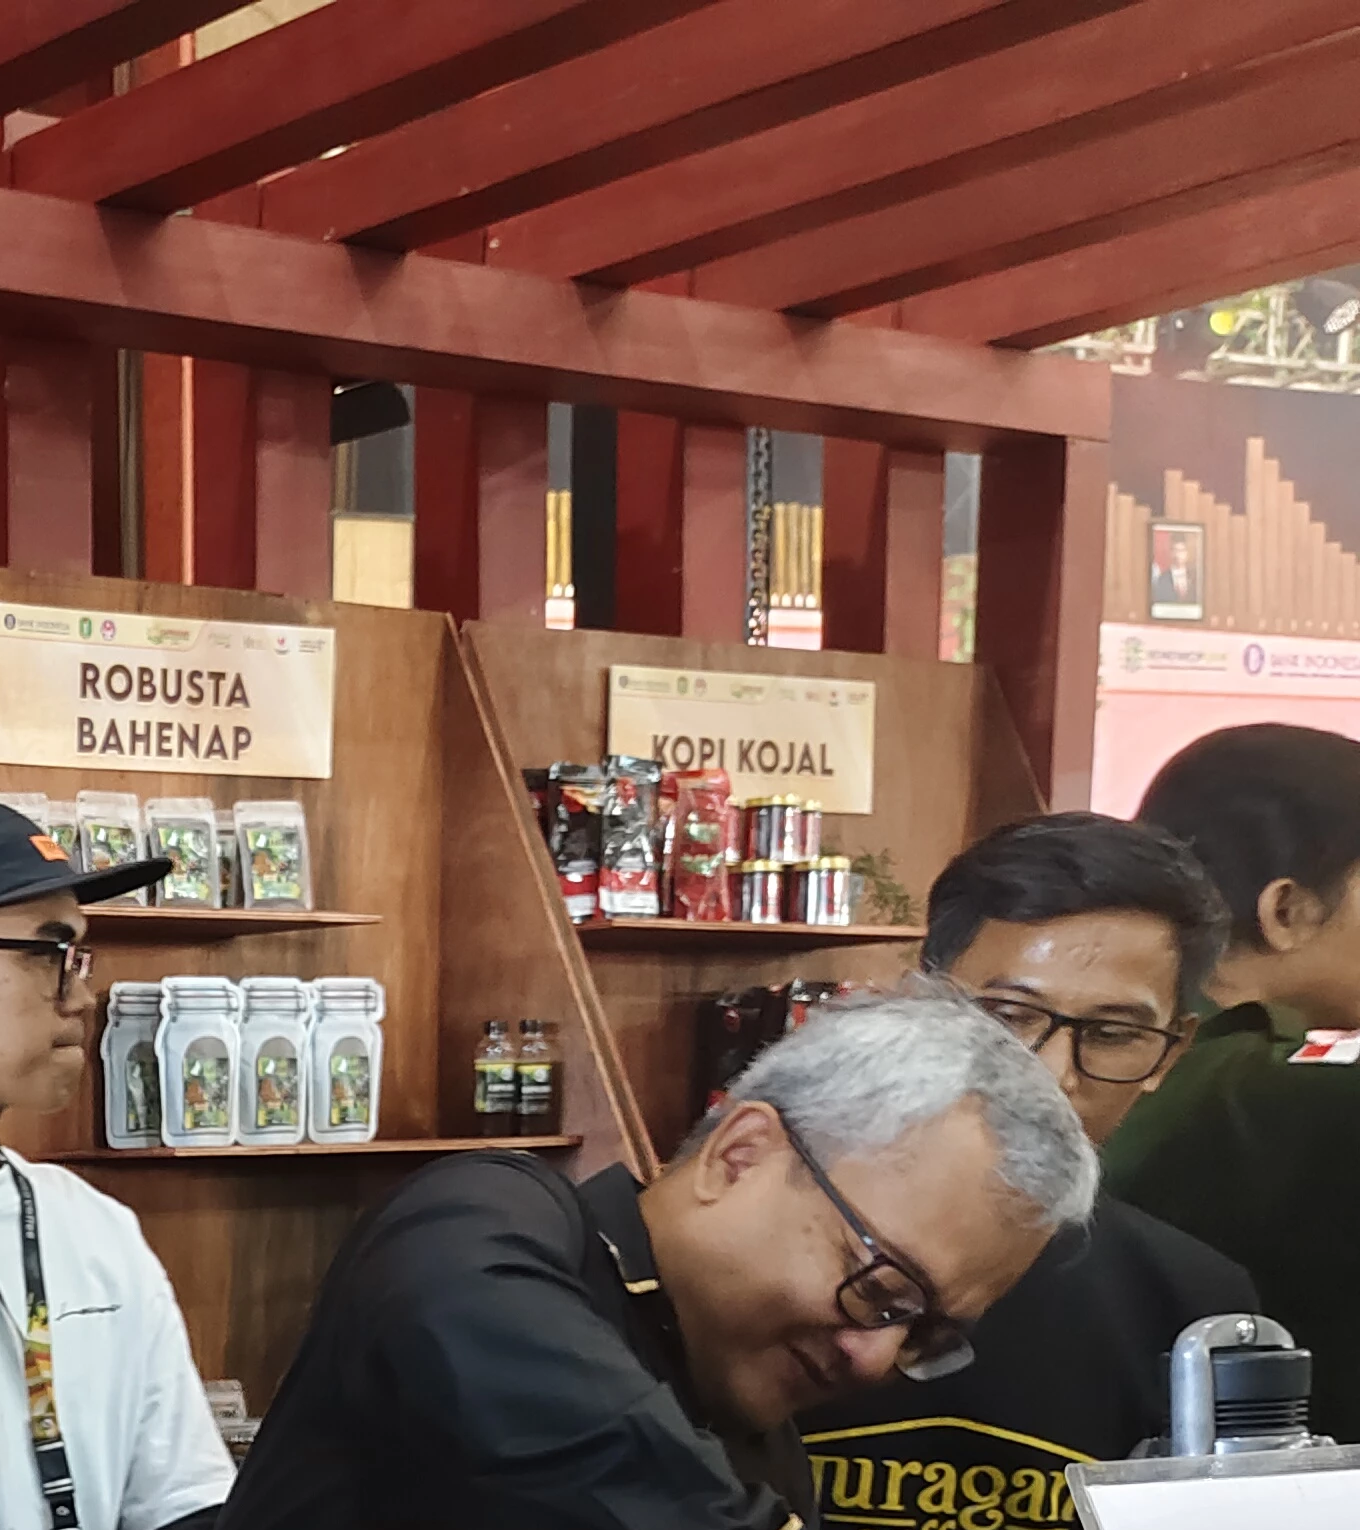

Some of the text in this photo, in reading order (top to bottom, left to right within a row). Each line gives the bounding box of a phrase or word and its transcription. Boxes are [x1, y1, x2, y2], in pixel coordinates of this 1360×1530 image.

[79, 662, 251, 709] ROBUSTA
[76, 716, 252, 761] BAHENAP
[653, 734, 835, 777] KOPI KOJAL
